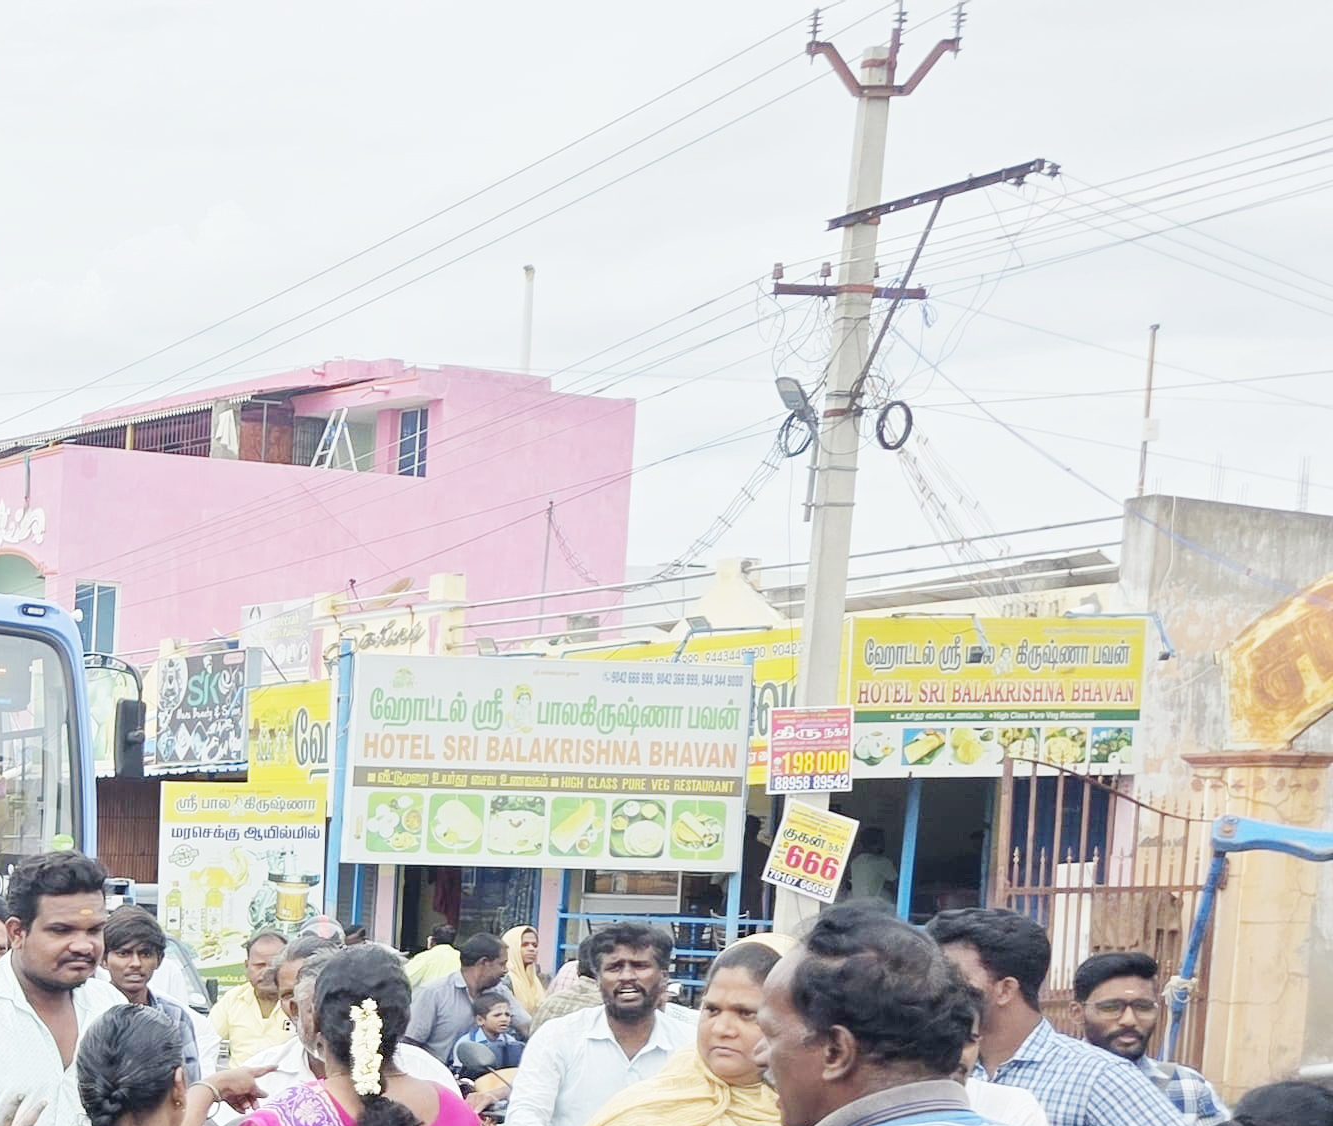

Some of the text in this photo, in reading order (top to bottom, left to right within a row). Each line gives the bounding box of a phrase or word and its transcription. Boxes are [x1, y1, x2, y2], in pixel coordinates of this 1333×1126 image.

[865, 639, 935, 671] ஹோட்டல்
[1016, 639, 1089, 670] கிருஷ்ணா
[1093, 640, 1130, 664] பவன்
[858, 681, 1133, 703] HOTEL SRI BALAKRISHNA BHAVAN
[370, 687, 467, 728] ஹோட்டல்
[537, 695, 683, 735] பாலகிருஷ்ணா
[688, 698, 741, 731] பவன்
[363, 732, 435, 760] HOTEL
[443, 734, 479, 761] SRI
[485, 736, 641, 766] BALAKRISHNA
[649, 741, 737, 769] BHAVAN
[561, 776, 735, 793] HIGH CLASS PURE VEG RESTAURANT
[774, 775, 849, 791] 88958 89542
[244, 796, 316, 812] கிருஷ்ணா
[785, 845, 839, 880] 666
[769, 870, 832, 897] 70107 66055
